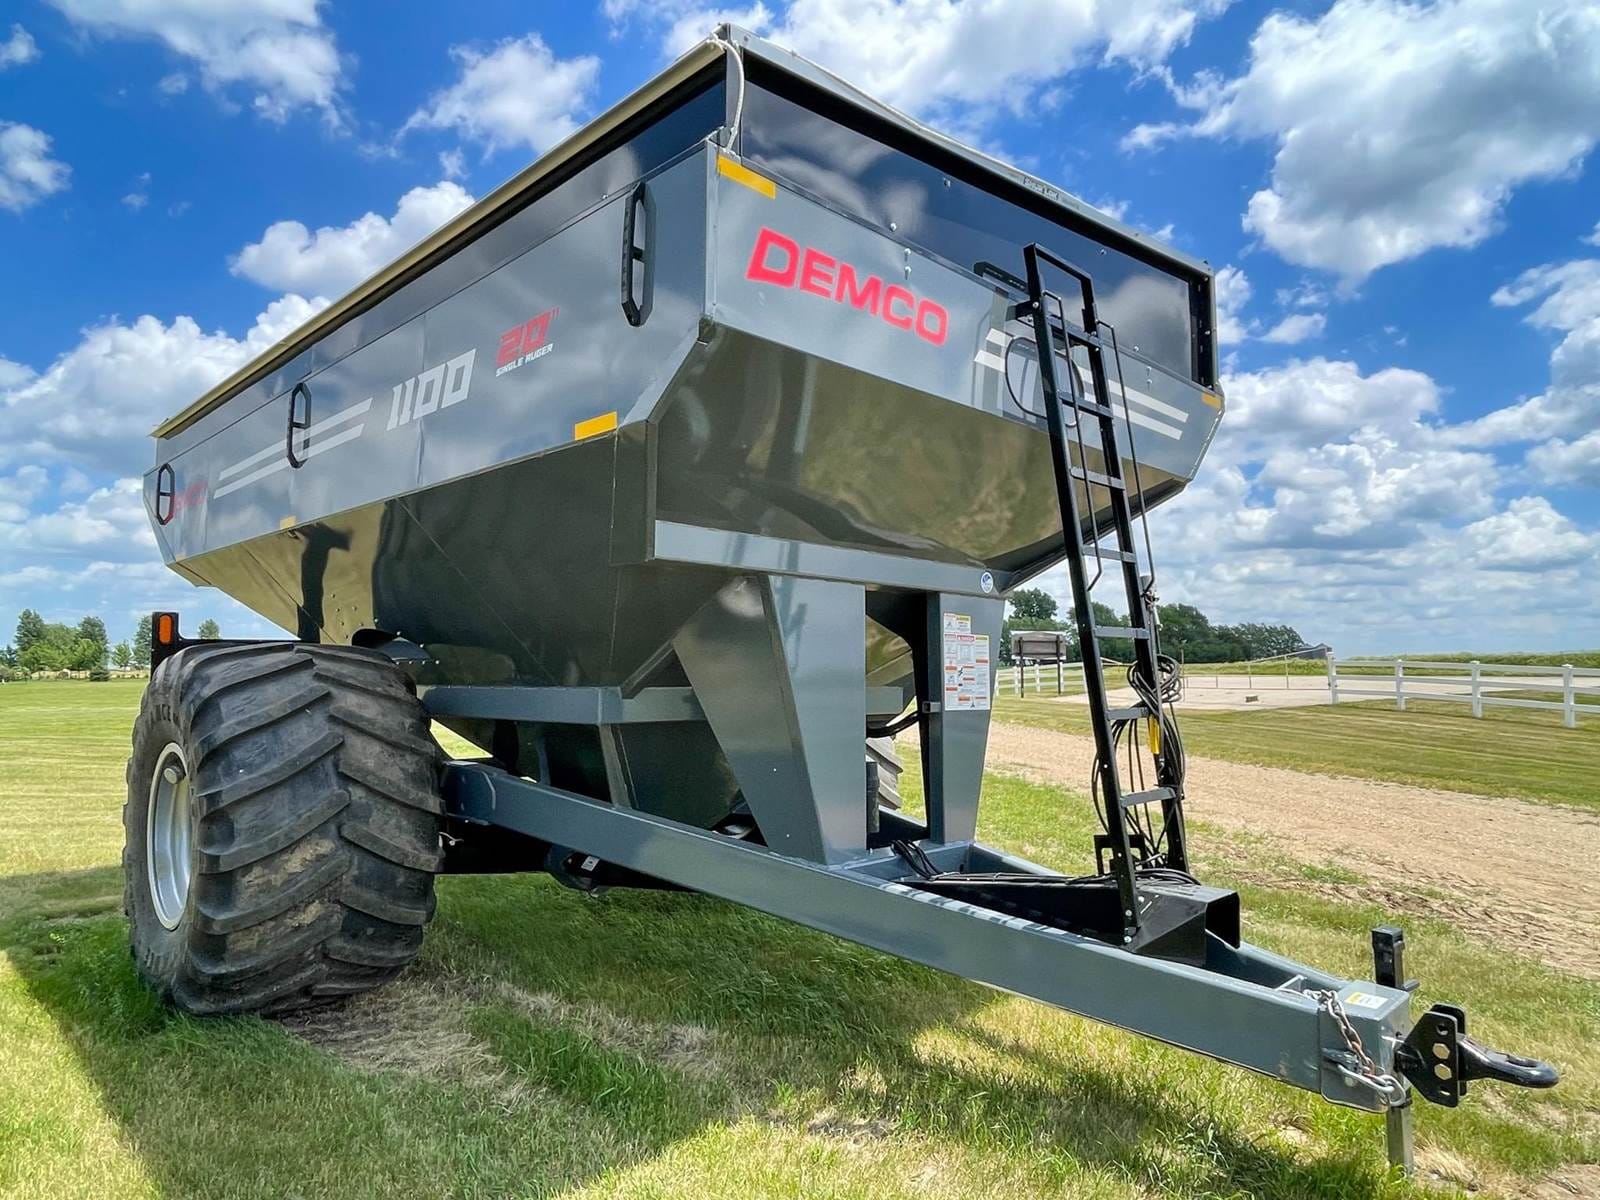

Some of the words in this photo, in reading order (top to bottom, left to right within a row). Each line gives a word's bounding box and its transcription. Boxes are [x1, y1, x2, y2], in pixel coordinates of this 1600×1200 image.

[746, 227, 948, 346] DEMCO
[387, 348, 477, 431] 1100
[496, 357, 524, 377] SINGLE
